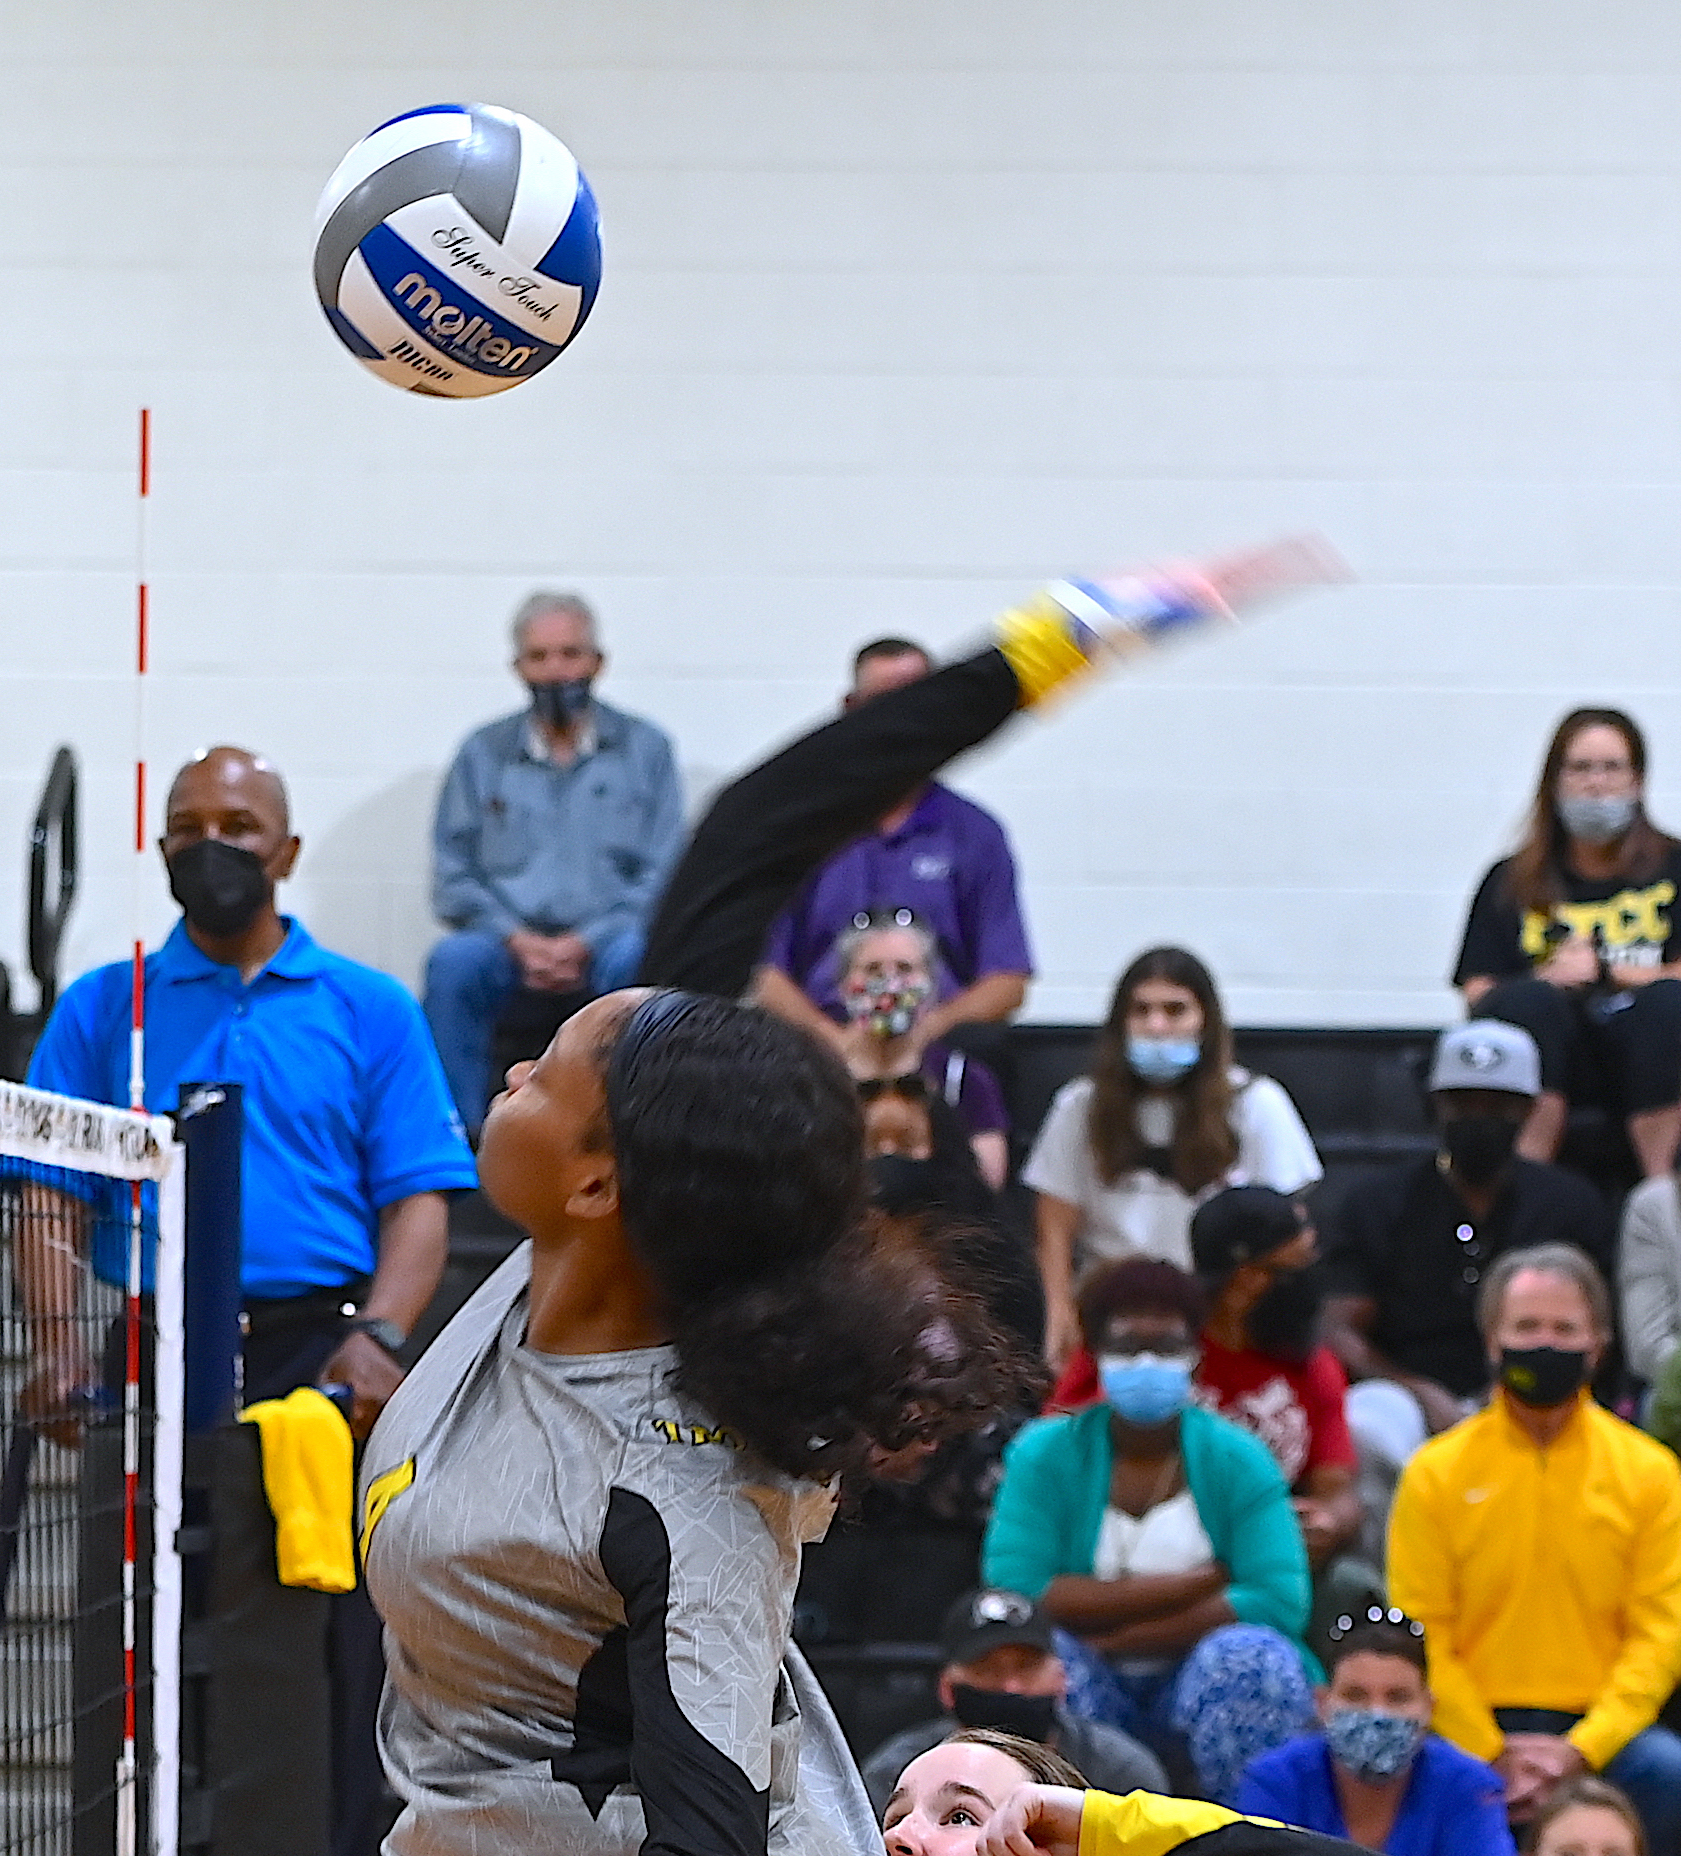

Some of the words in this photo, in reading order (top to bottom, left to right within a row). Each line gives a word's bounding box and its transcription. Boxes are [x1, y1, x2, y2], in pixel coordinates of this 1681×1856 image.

[392, 272, 536, 371] molten
[430, 226, 495, 280] Super
[498, 277, 560, 323] Touch
